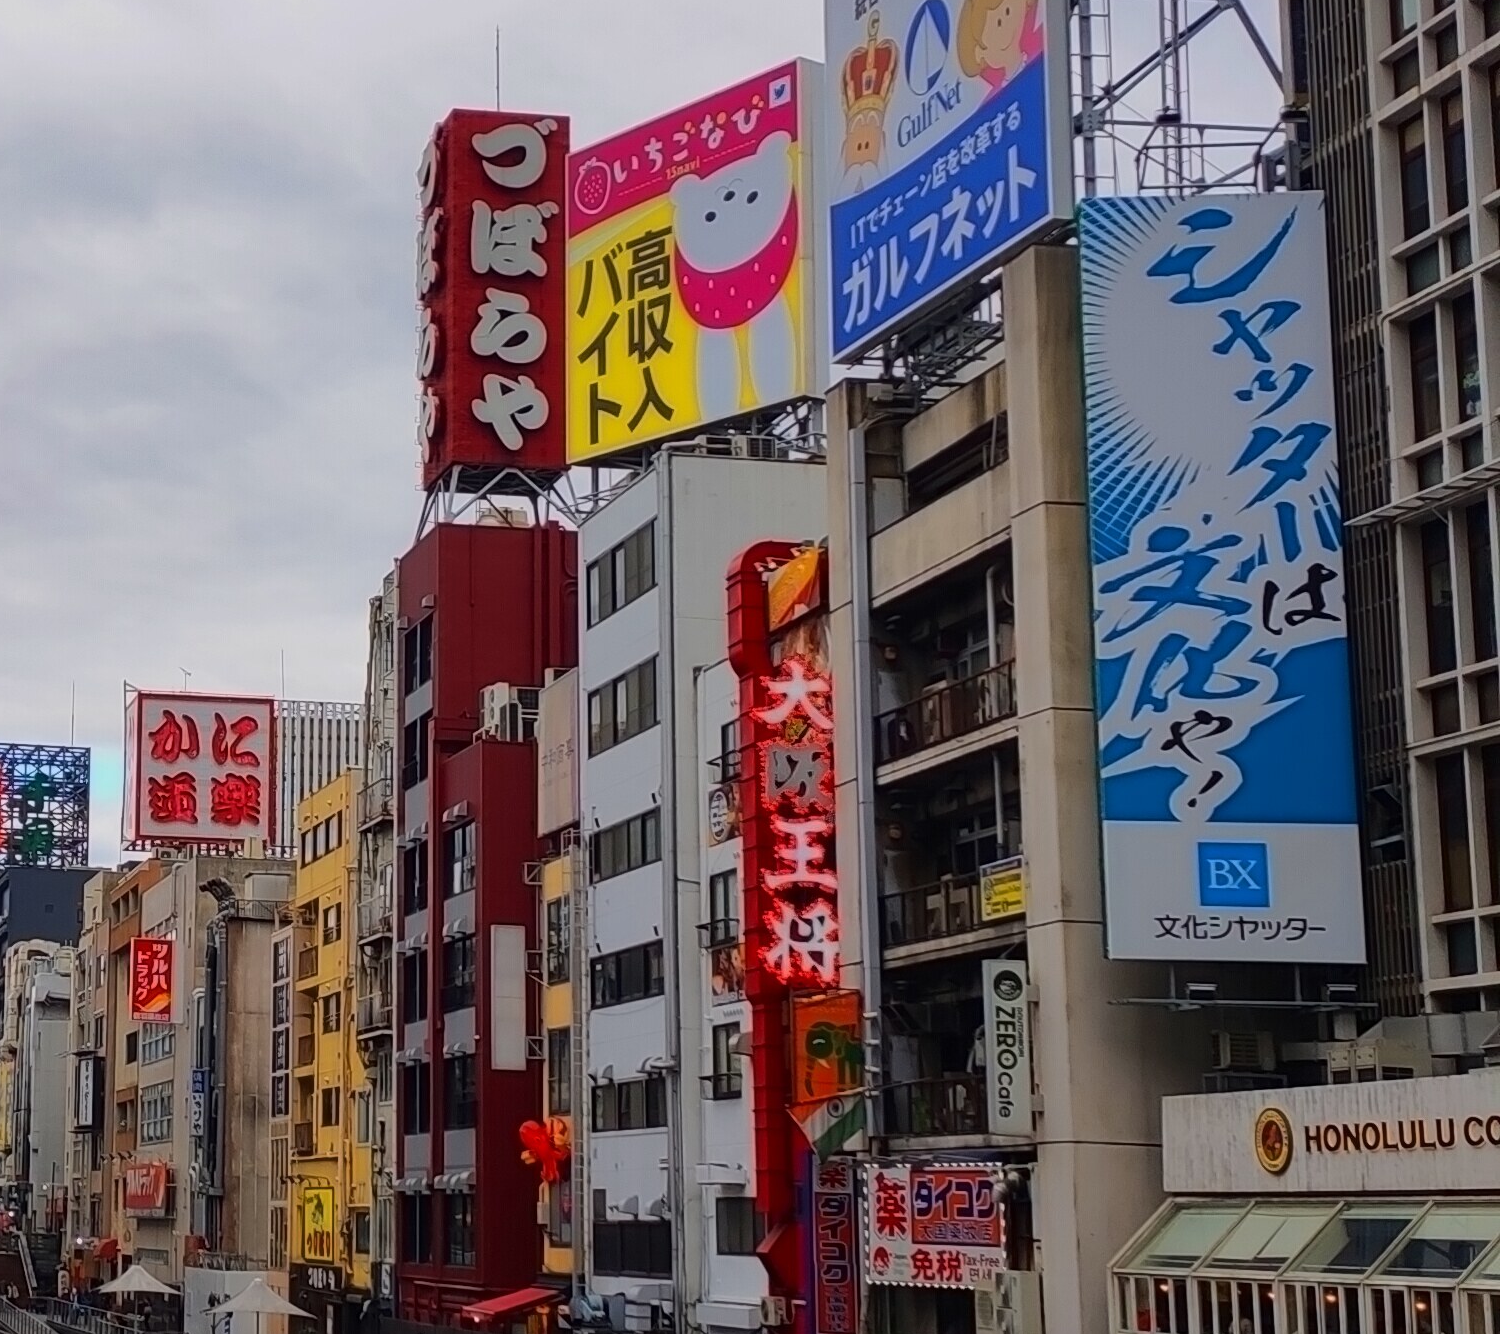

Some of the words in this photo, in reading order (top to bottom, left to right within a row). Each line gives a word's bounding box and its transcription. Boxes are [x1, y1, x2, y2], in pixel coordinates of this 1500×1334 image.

[613, 93, 765, 184] いちごなび
[897, 78, 962, 149] GulfNet
[850, 99, 1022, 249] ITでチェーン店を改革する
[842, 145, 1038, 334] ガルフネット
[470, 118, 561, 452] づぼらや
[576, 242, 627, 446] バイト
[627, 225, 675, 433] 高収入
[148, 709, 261, 767] かに
[750, 657, 841, 988] 大阪王将
[1206, 857, 1260, 890] BX
[136, 950, 154, 1002] ドラッグ
[151, 942, 169, 991] ツルハ
[995, 1005, 1018, 1070] ZERO
[1304, 1117, 1456, 1153] HONOLULU
[875, 1171, 908, 1238] 薬
[913, 1175, 997, 1220] ダイコク
[820, 1195, 850, 1285] ダイコク
[910, 1248, 963, 1282] 免税
[963, 1252, 1001, 1269] Tax-Free
